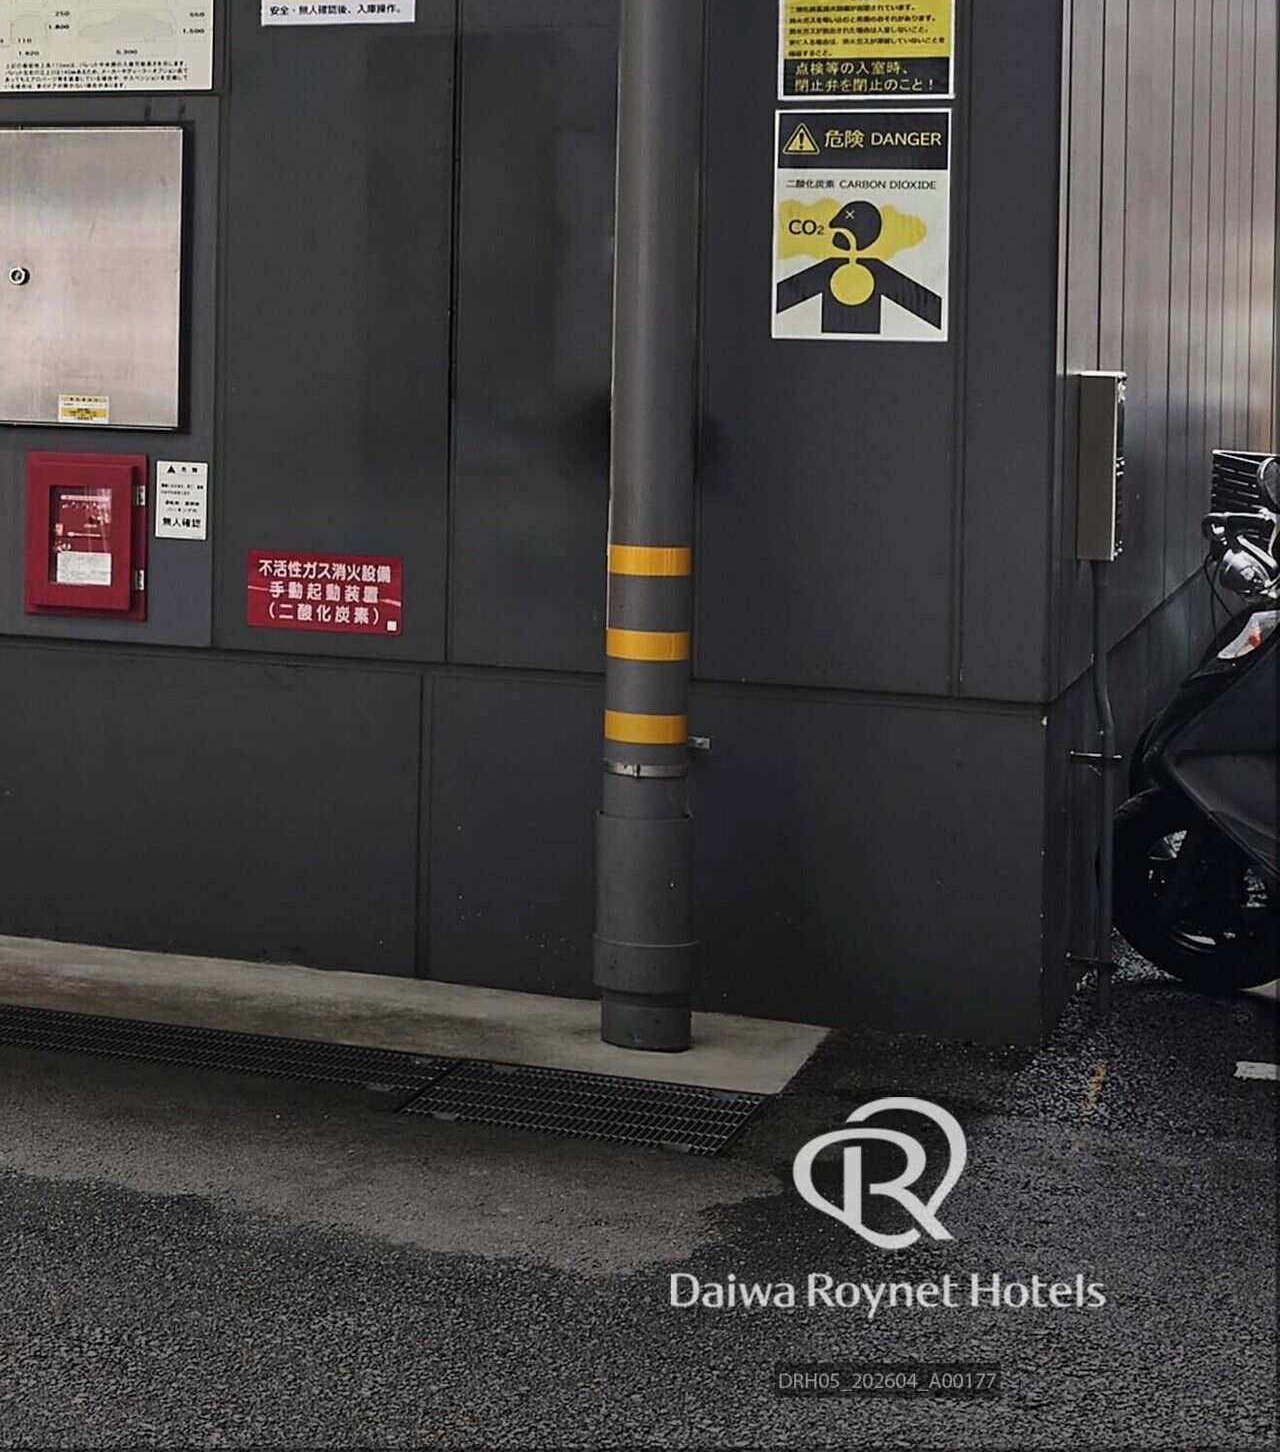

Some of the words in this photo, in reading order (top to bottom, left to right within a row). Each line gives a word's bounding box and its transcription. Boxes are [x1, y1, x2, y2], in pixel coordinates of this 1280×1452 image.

[795, 61, 909, 76] 点検等の入室時、
[824, 129, 865, 149] 危険
[871, 131, 942, 147] DANGER
[786, 178, 835, 191] 二酸化炭素
[839, 179, 887, 191] CARBON
[889, 179, 937, 191] DIOXIDE
[162, 517, 202, 528] 無人確認
[258, 559, 392, 584] 不活性ガス消火設備
[269, 581, 380, 604] 手動起動装置
[267, 604, 382, 626] （二酸化炭素）
